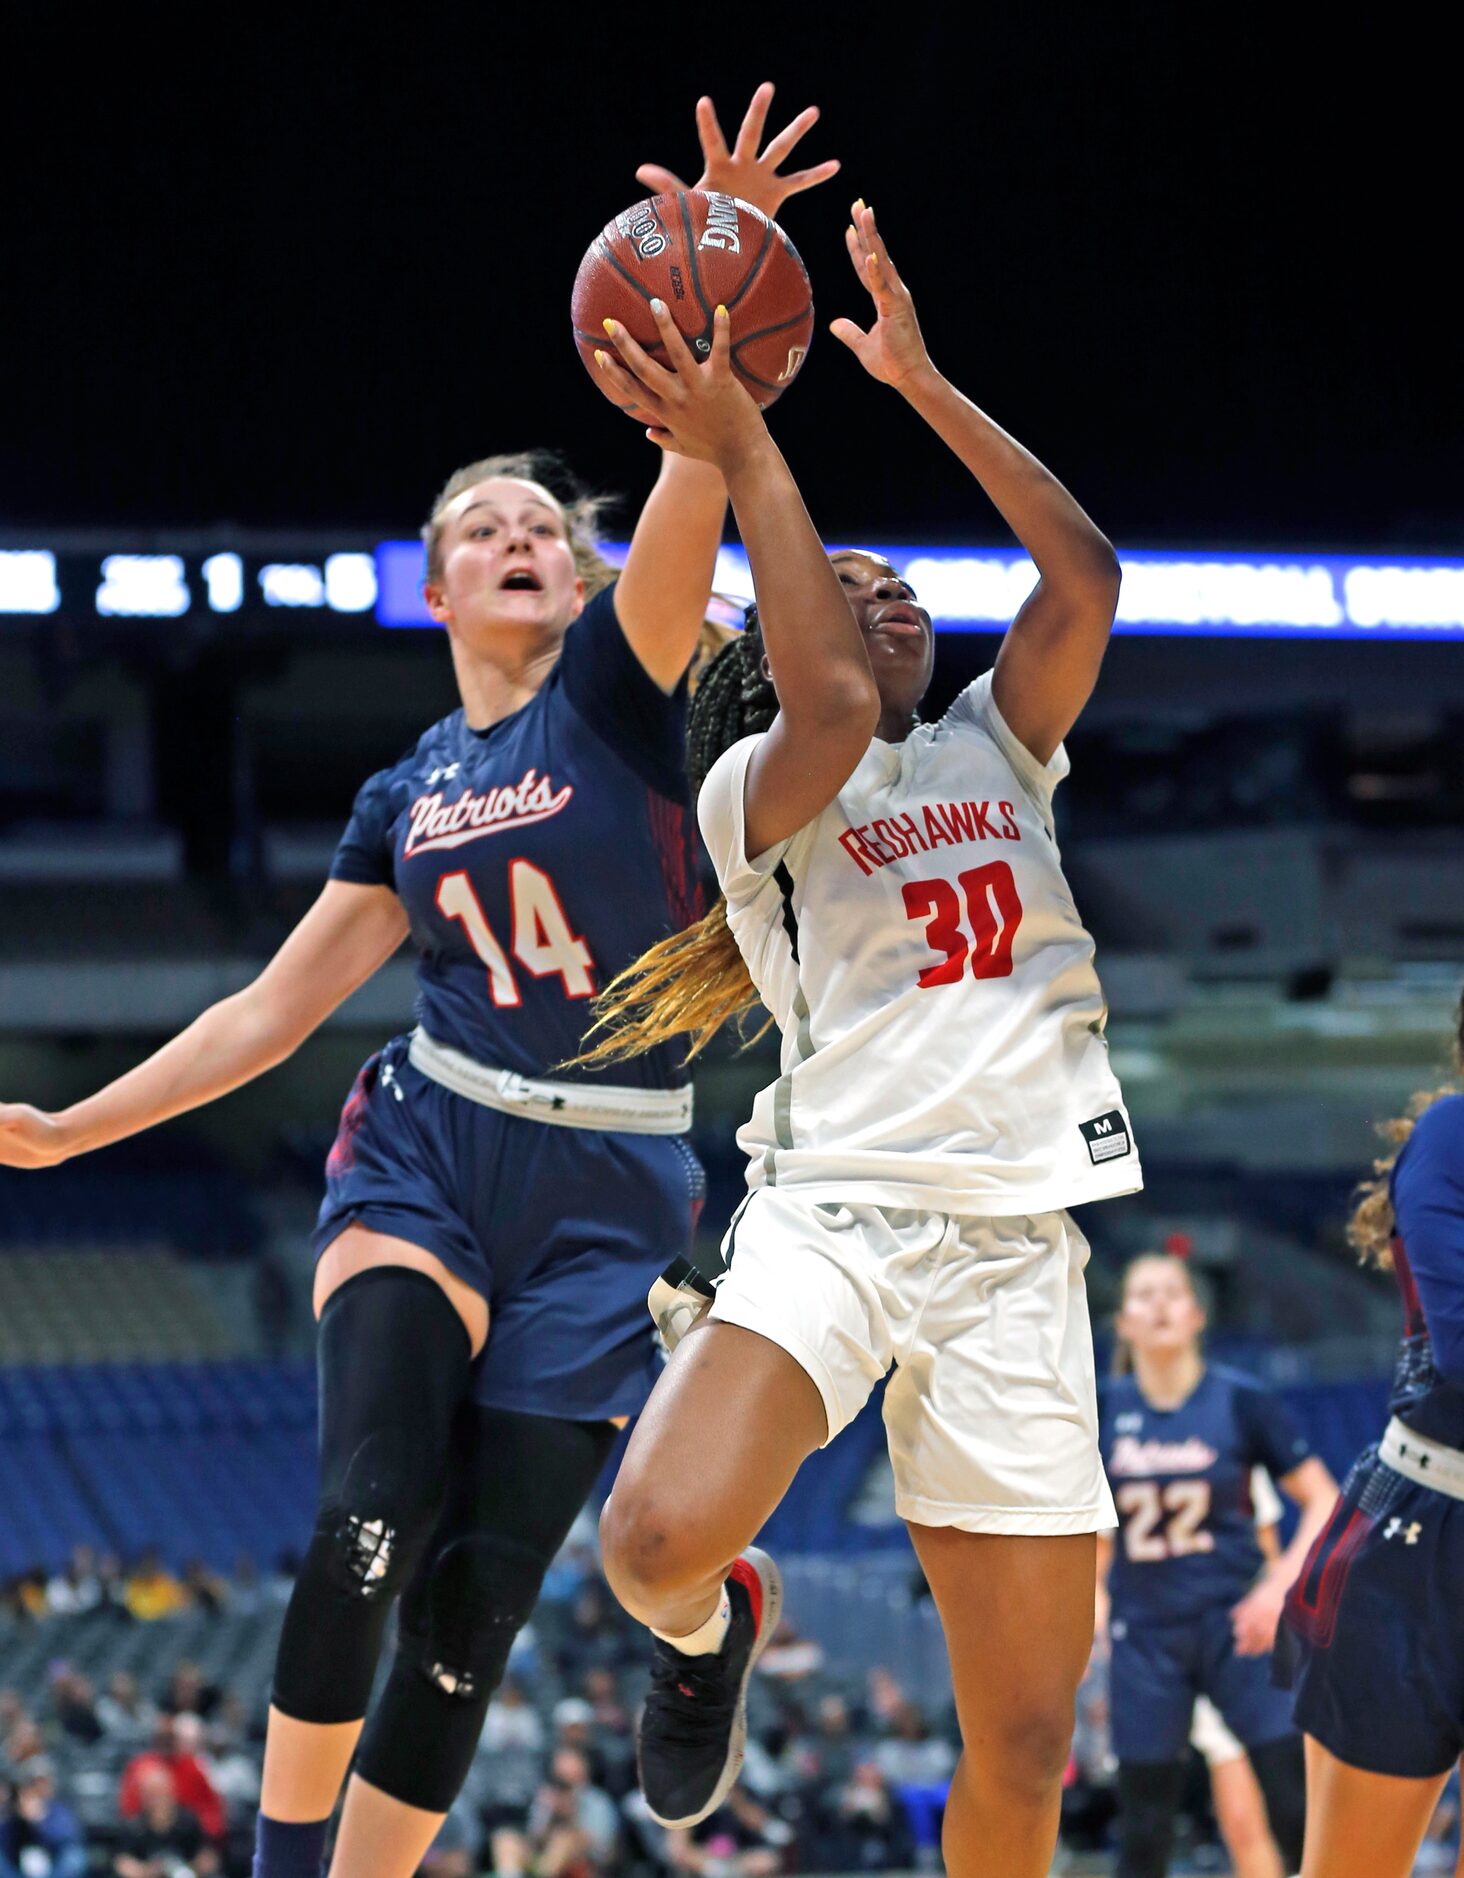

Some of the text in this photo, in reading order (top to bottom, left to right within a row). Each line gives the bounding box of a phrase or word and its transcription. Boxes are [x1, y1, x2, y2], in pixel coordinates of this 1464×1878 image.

[403, 767, 573, 861] Patriots
[837, 800, 1021, 877] REDHAWKS
[434, 855, 597, 1008] 14
[901, 859, 1023, 989] 30
[1093, 1118, 1113, 1135] M
[1115, 1481, 1215, 1562] 22
